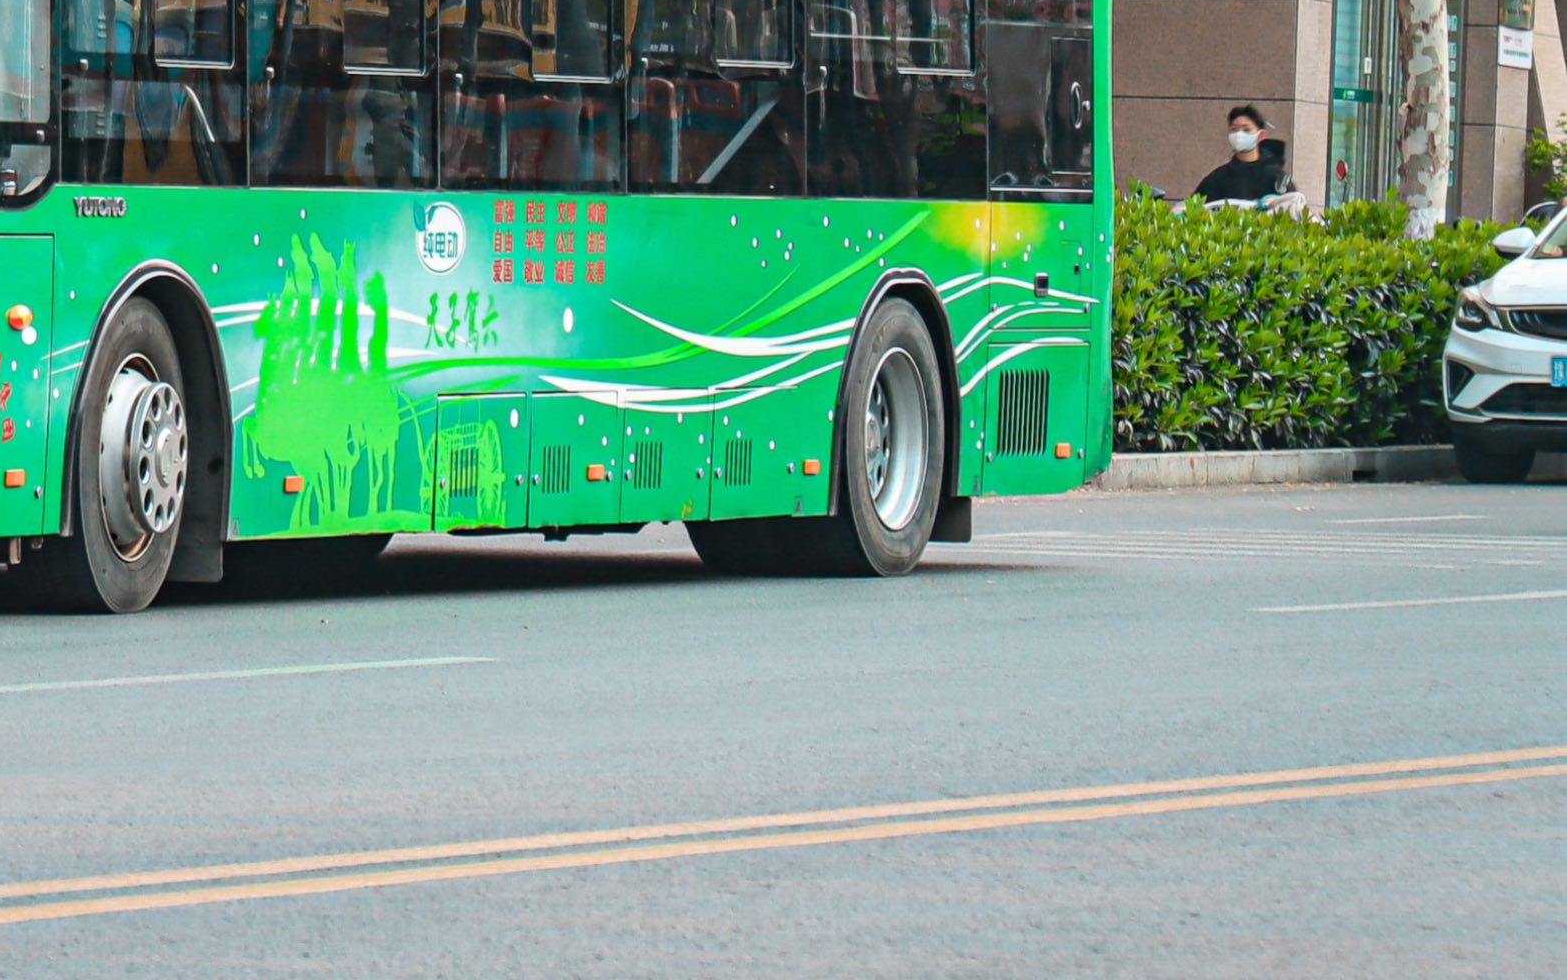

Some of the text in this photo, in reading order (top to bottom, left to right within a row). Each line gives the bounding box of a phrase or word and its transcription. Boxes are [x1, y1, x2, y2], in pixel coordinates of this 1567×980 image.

[495, 200, 607, 225] 富强 民主 文明 和谐
[423, 232, 458, 258] 纯电动
[494, 229, 605, 254] 自由 平等 公正 法治
[493, 259, 605, 284] 爱国 敬业 诚信 友善
